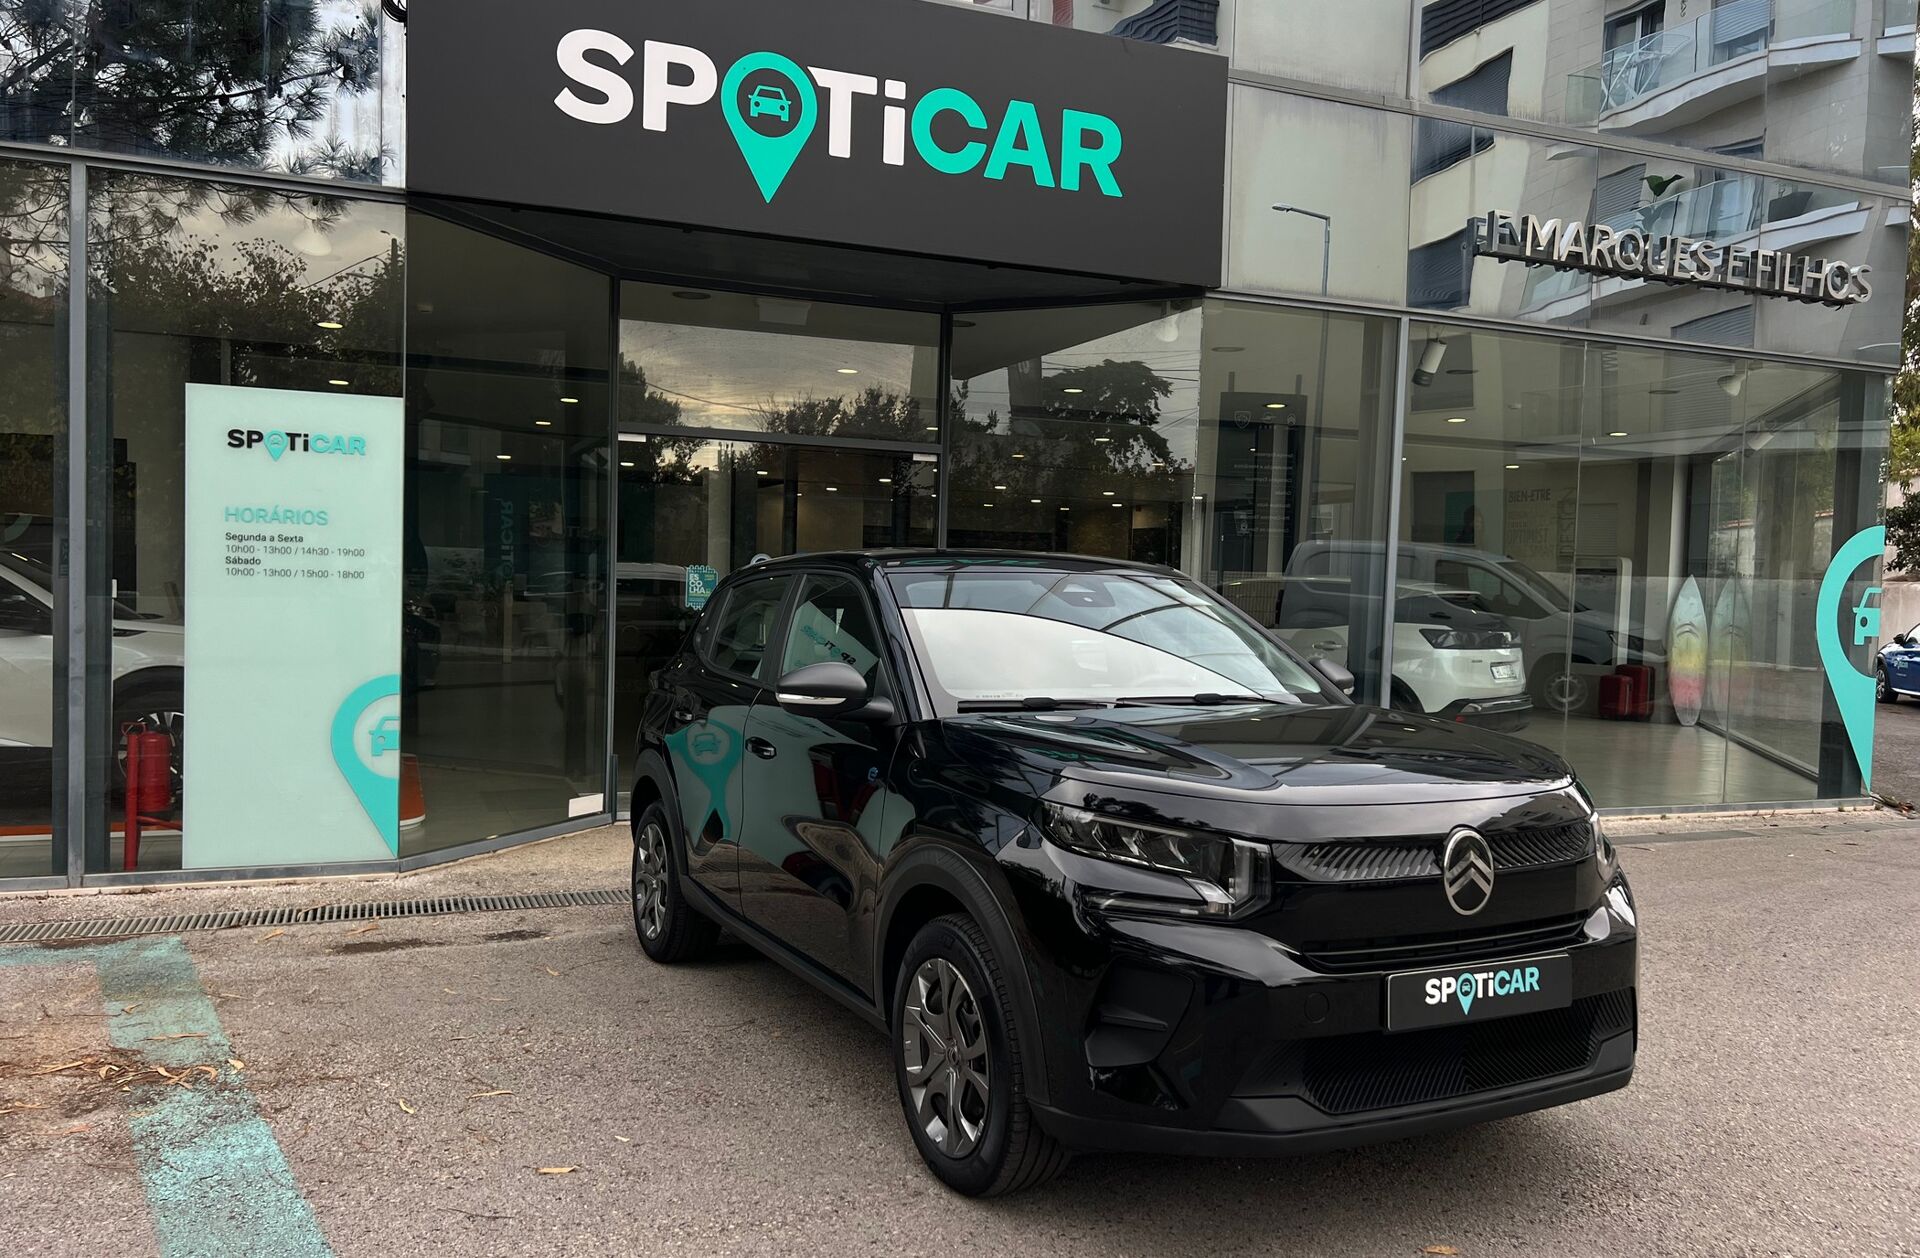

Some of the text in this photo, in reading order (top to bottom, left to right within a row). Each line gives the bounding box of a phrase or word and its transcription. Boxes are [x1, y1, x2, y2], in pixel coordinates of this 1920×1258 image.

[1521, 214, 1715, 282] MARQUES
[1722, 245, 1747, 286] E
[1750, 248, 1874, 302] FILHOS
[224, 505, 328, 526] HORÁRIOS
[225, 532, 267, 543] Segunda
[277, 534, 304, 543] Sexta
[225, 544, 255, 554] 10h00
[264, 545, 292, 555] 13h00
[301, 546, 329, 556] 14h30
[337, 547, 365, 557] 19h00
[225, 555, 261, 565] Sábado
[225, 567, 255, 576] 10h00
[264, 568, 292, 577] 13h00
[301, 569, 329, 578] 15h00
[337, 569, 365, 579] 18h00
